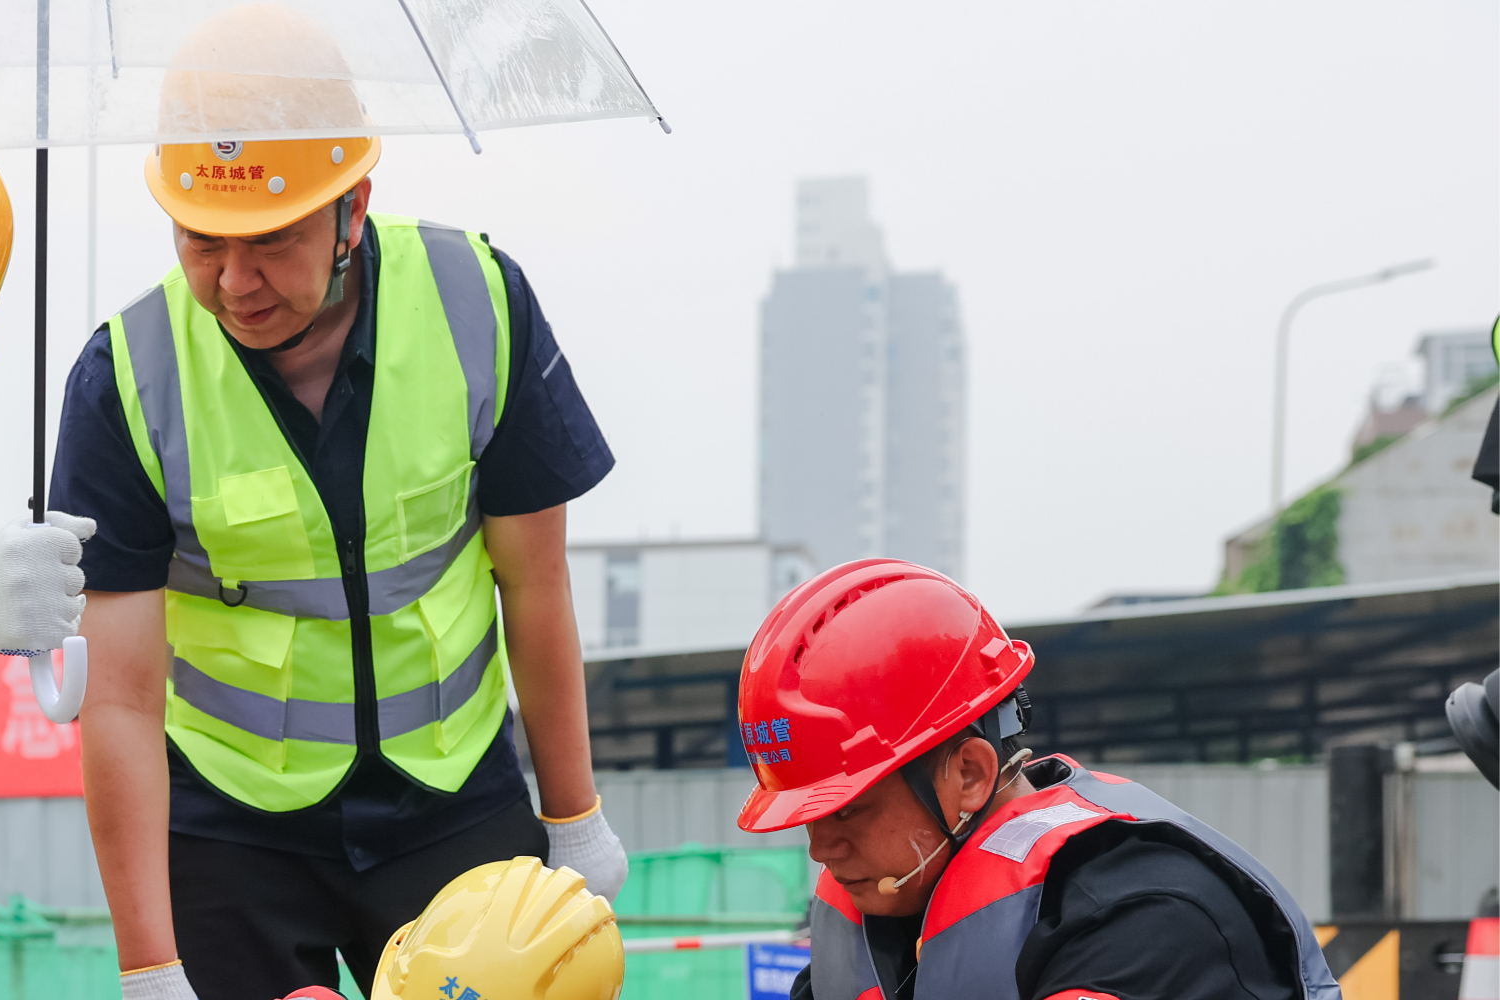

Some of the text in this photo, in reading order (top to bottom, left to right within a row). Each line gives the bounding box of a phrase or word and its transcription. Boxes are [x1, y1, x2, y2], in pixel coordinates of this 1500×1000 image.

[196, 163, 265, 180] 太原城管
[203, 183, 257, 193] 市政建管中心
[741, 717, 791, 746] 原城管
